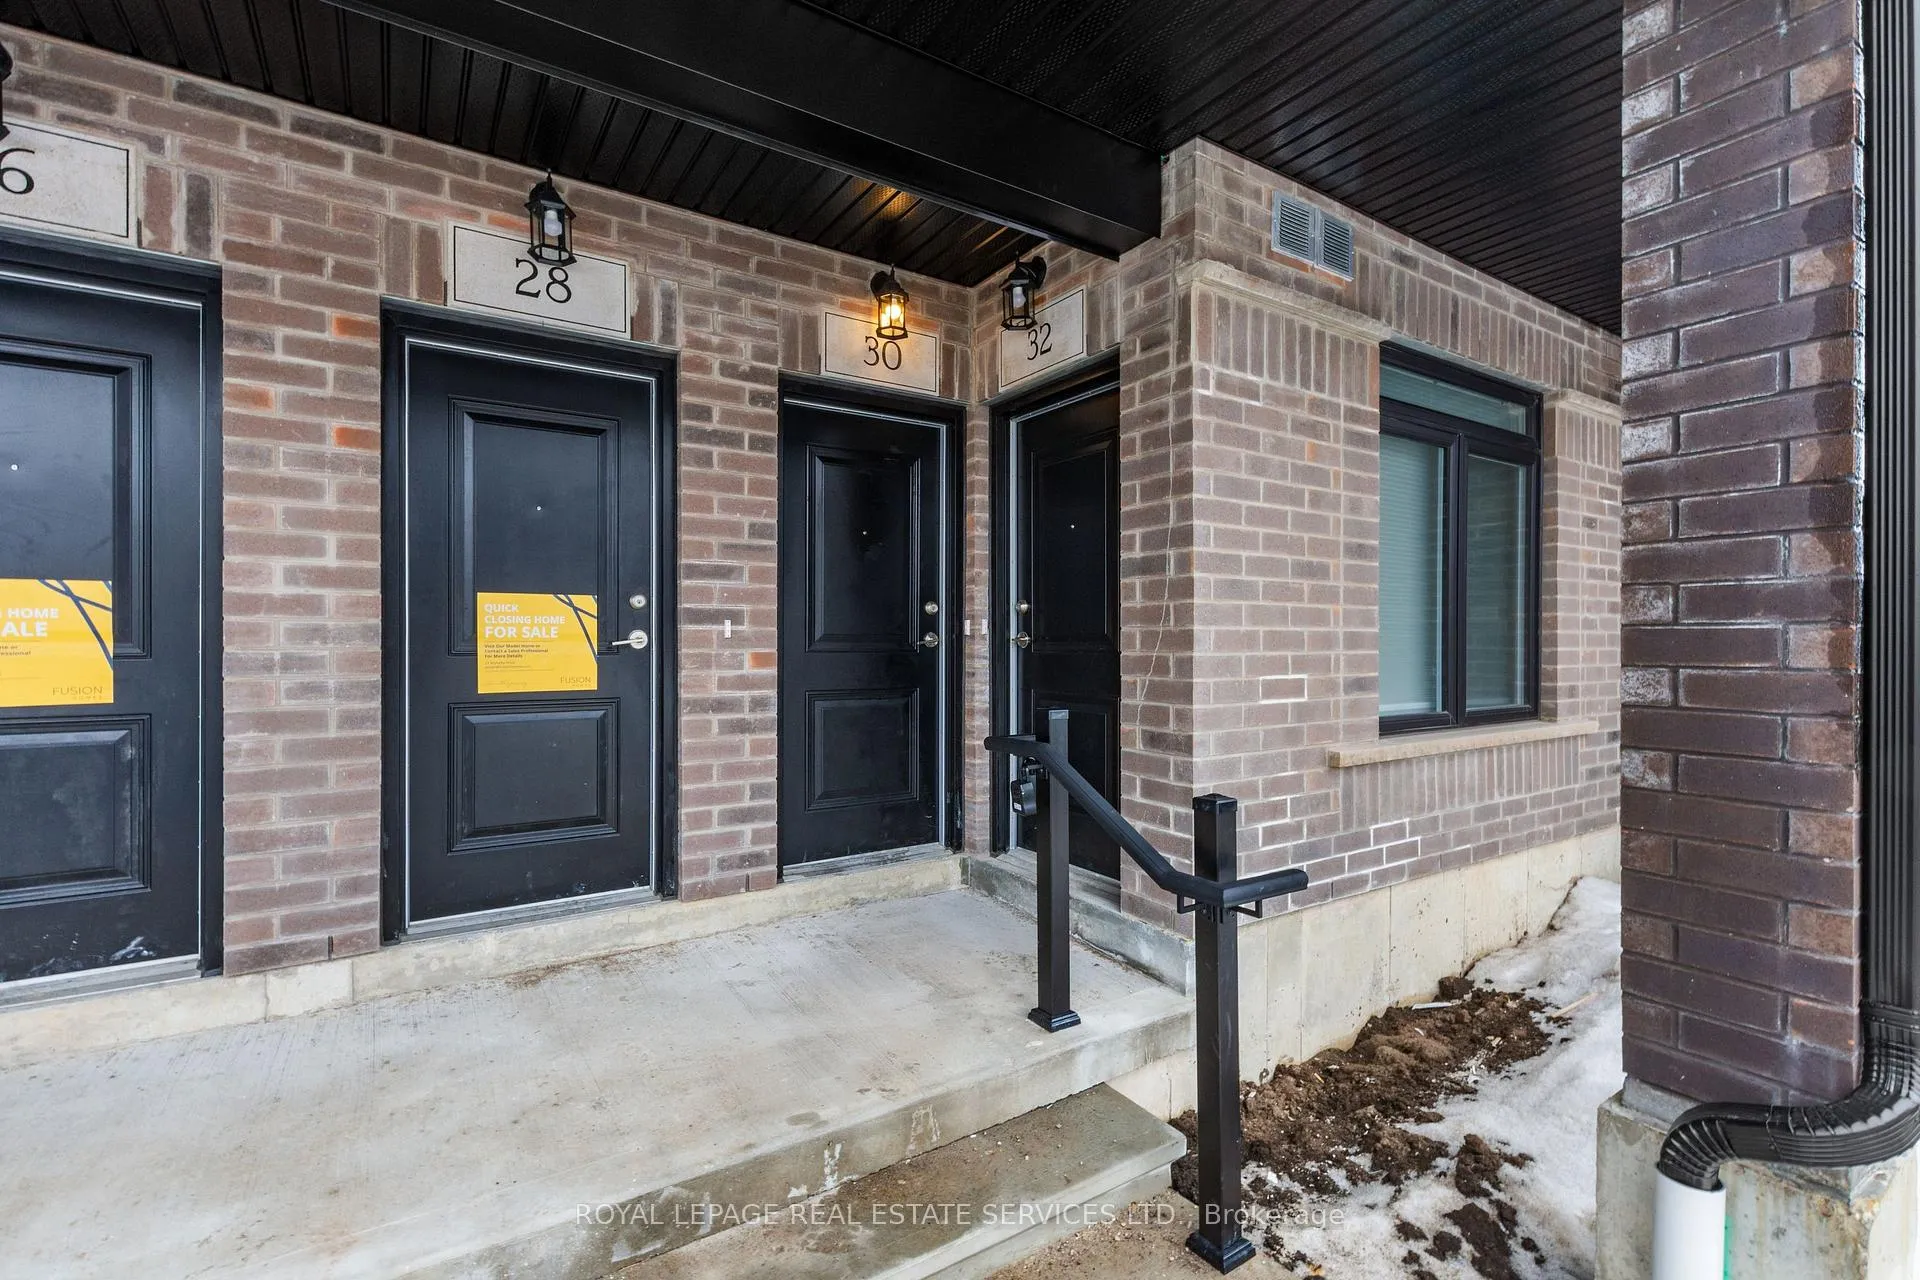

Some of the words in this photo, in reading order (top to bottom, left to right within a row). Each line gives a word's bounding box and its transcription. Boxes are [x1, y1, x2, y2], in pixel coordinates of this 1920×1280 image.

[515, 257, 572, 304] 28
[1027, 322, 1053, 361] 32
[863, 335, 902, 371] 30
[7, 607, 59, 618] HOME
[484, 603, 519, 614] QUICK
[484, 615, 531, 625] CLOSING
[534, 615, 566, 625] HOME
[484, 626, 518, 639] FOR
[521, 626, 559, 639] SALE
[560, 676, 591, 684] FUSION
[52, 686, 103, 696] FUSION
